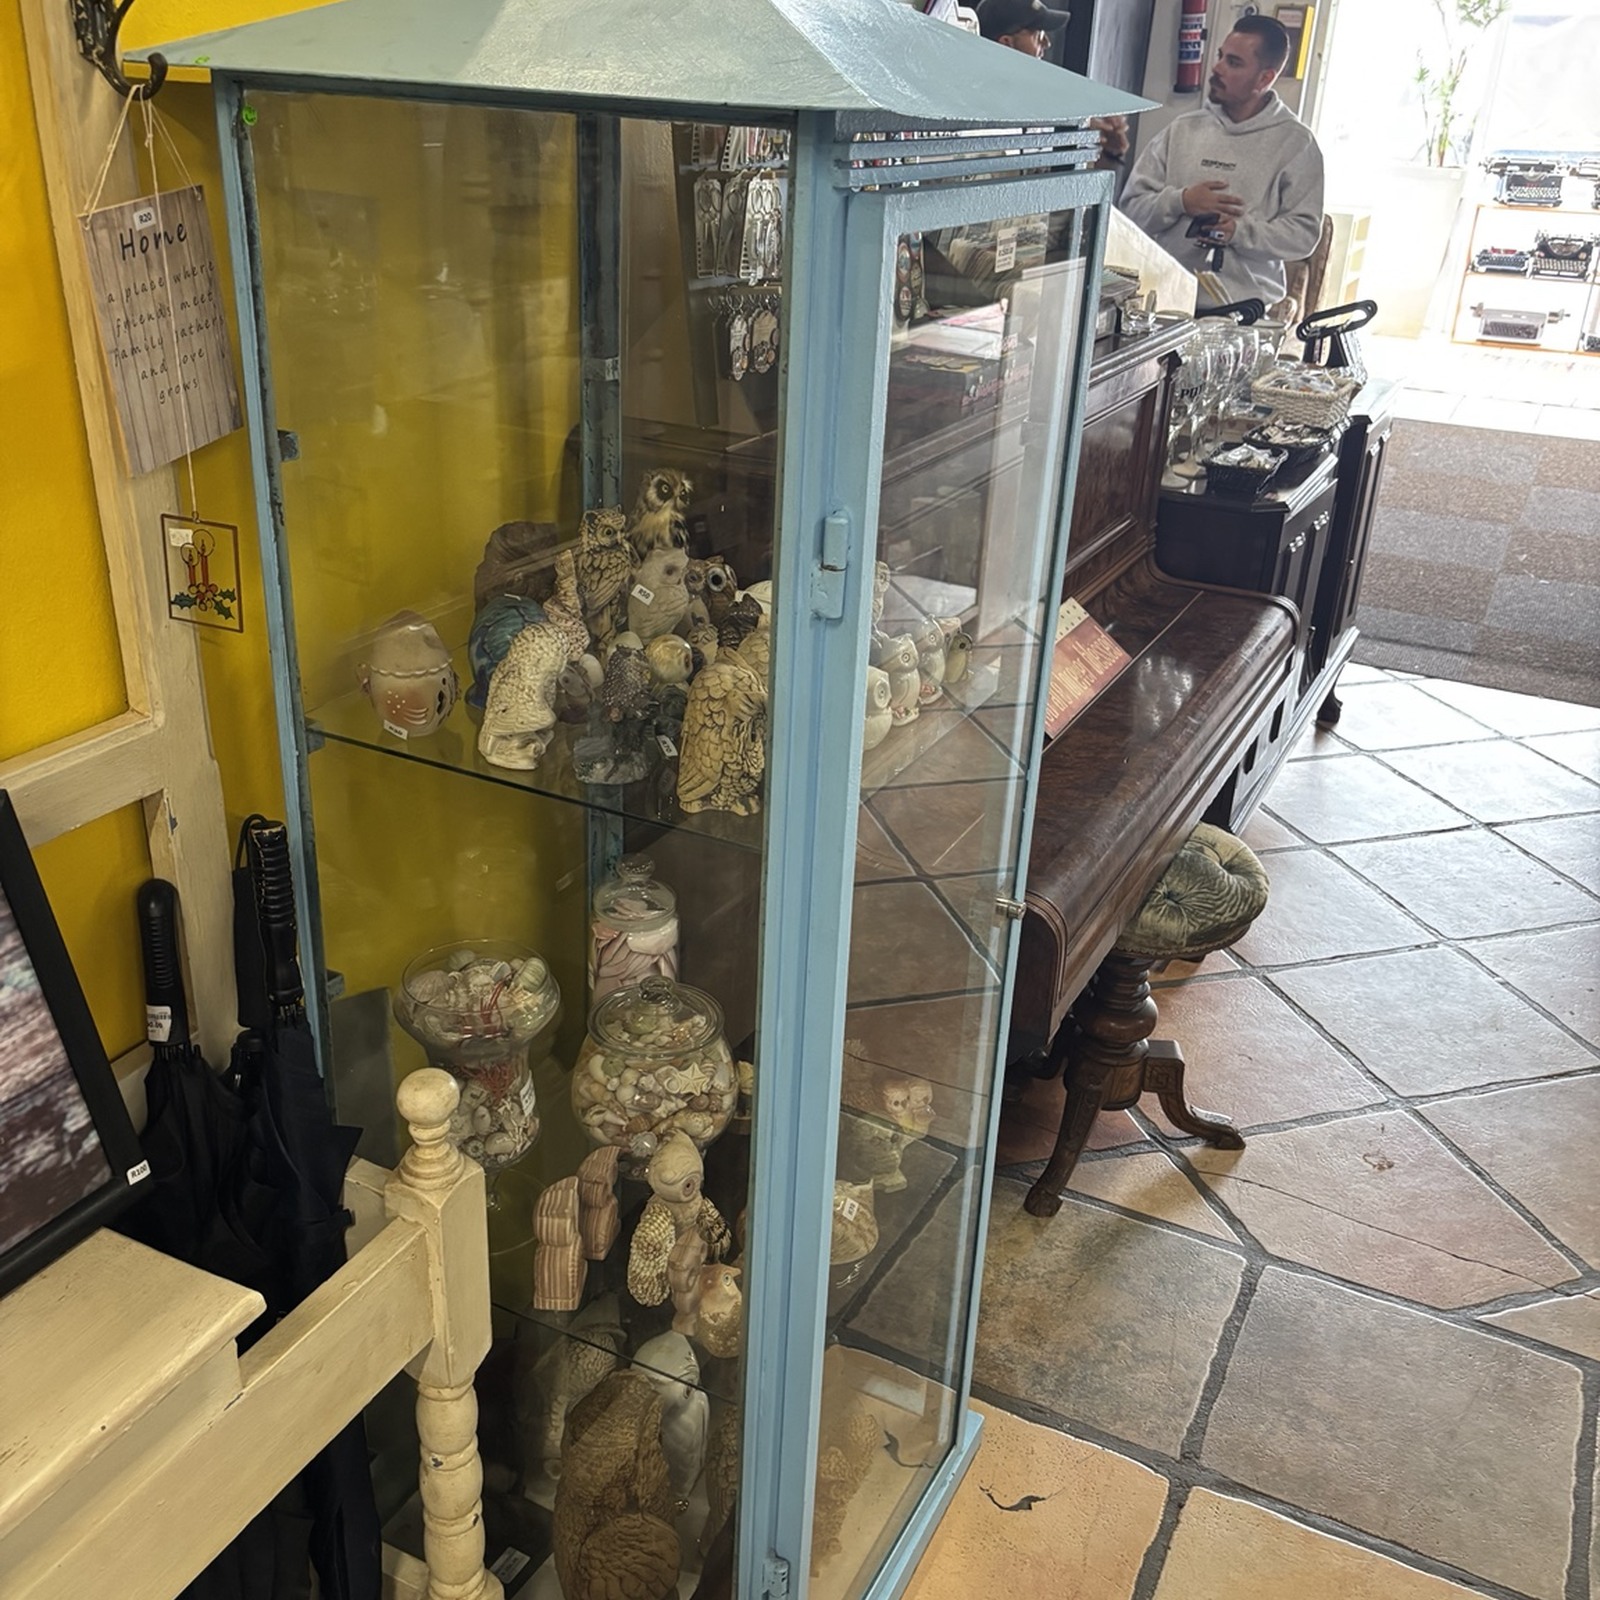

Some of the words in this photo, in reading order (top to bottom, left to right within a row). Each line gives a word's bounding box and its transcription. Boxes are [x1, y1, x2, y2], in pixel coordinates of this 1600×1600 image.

[139, 212, 152, 224] R20
[119, 223, 188, 261] Home
[107, 293, 115, 304] a
[124, 277, 165, 304] place
[173, 260, 215, 284] where
[115, 303, 172, 338] friends
[114, 337, 164, 367] family
[140, 361, 168, 381] and
[159, 379, 200, 405] grows
[638, 587, 651, 600] R50
[130, 1164, 148, 1179] R100
